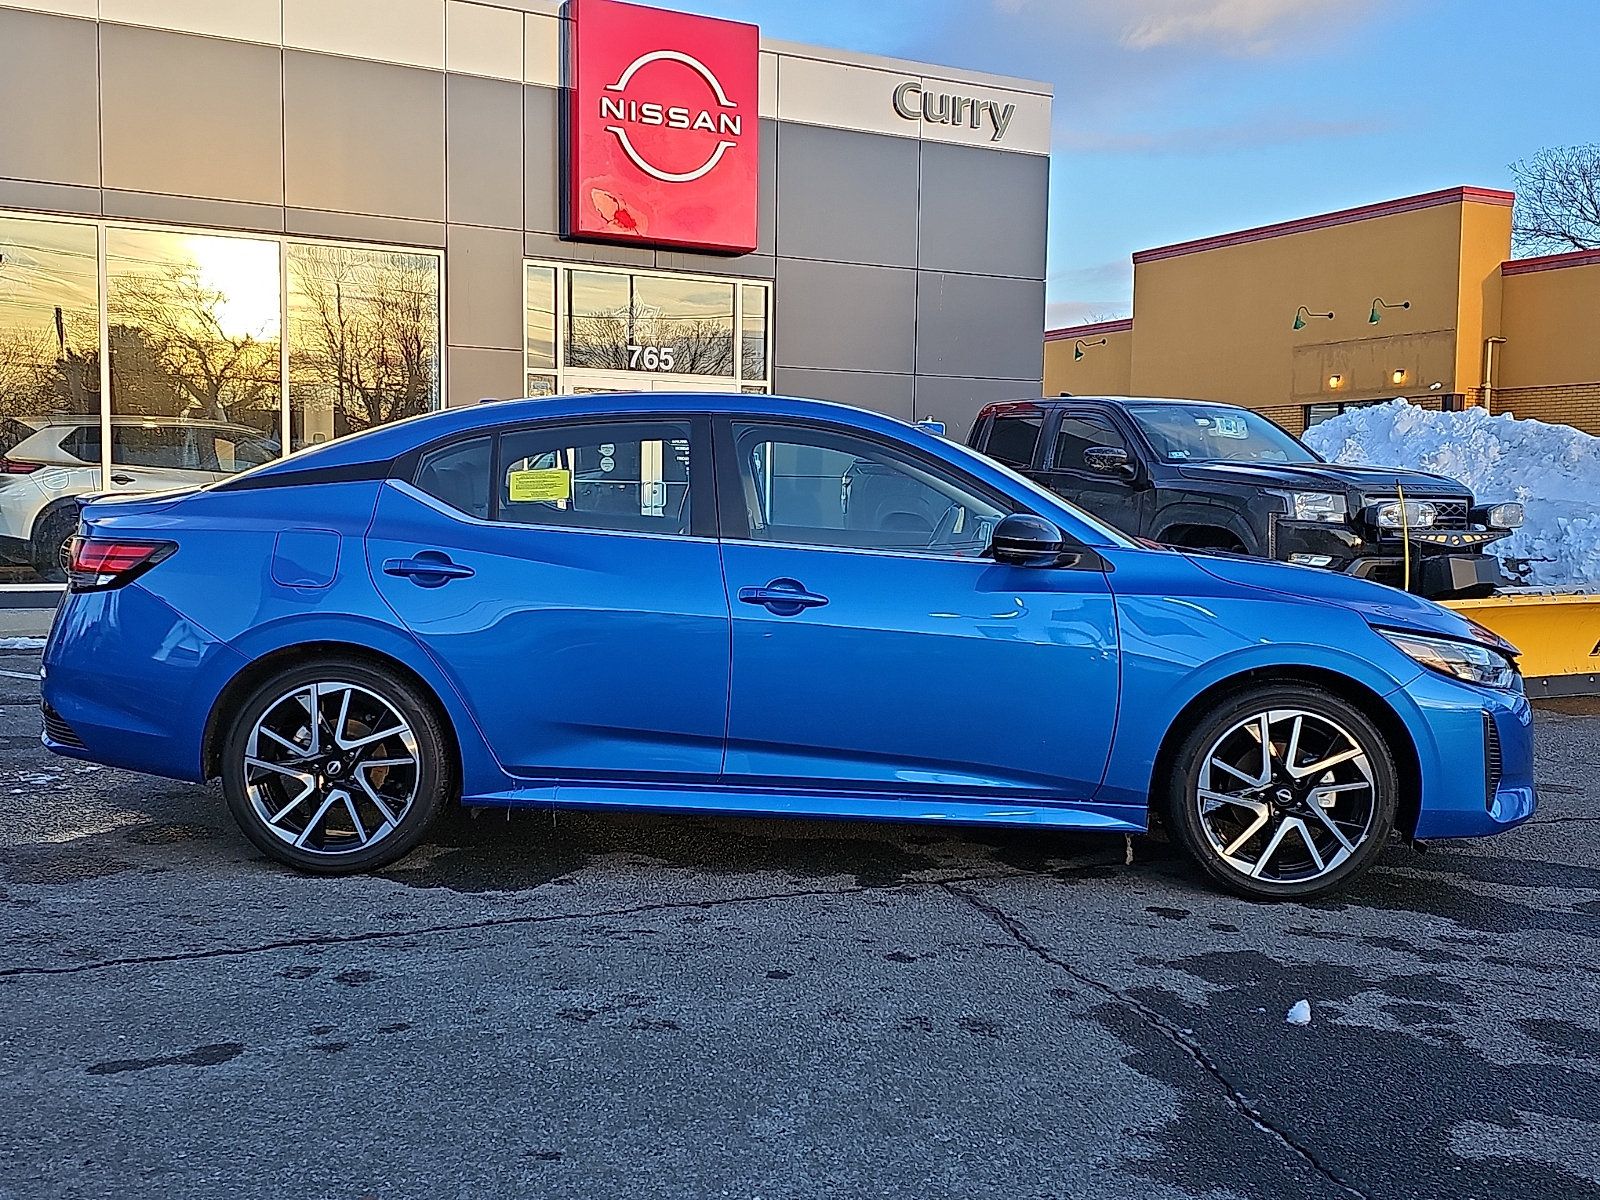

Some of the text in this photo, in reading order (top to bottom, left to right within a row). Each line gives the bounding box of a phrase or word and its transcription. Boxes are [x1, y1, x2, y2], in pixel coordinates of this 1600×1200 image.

[600, 96, 741, 136] NISSAN
[893, 81, 1016, 141] Curry
[627, 345, 674, 370] 765
